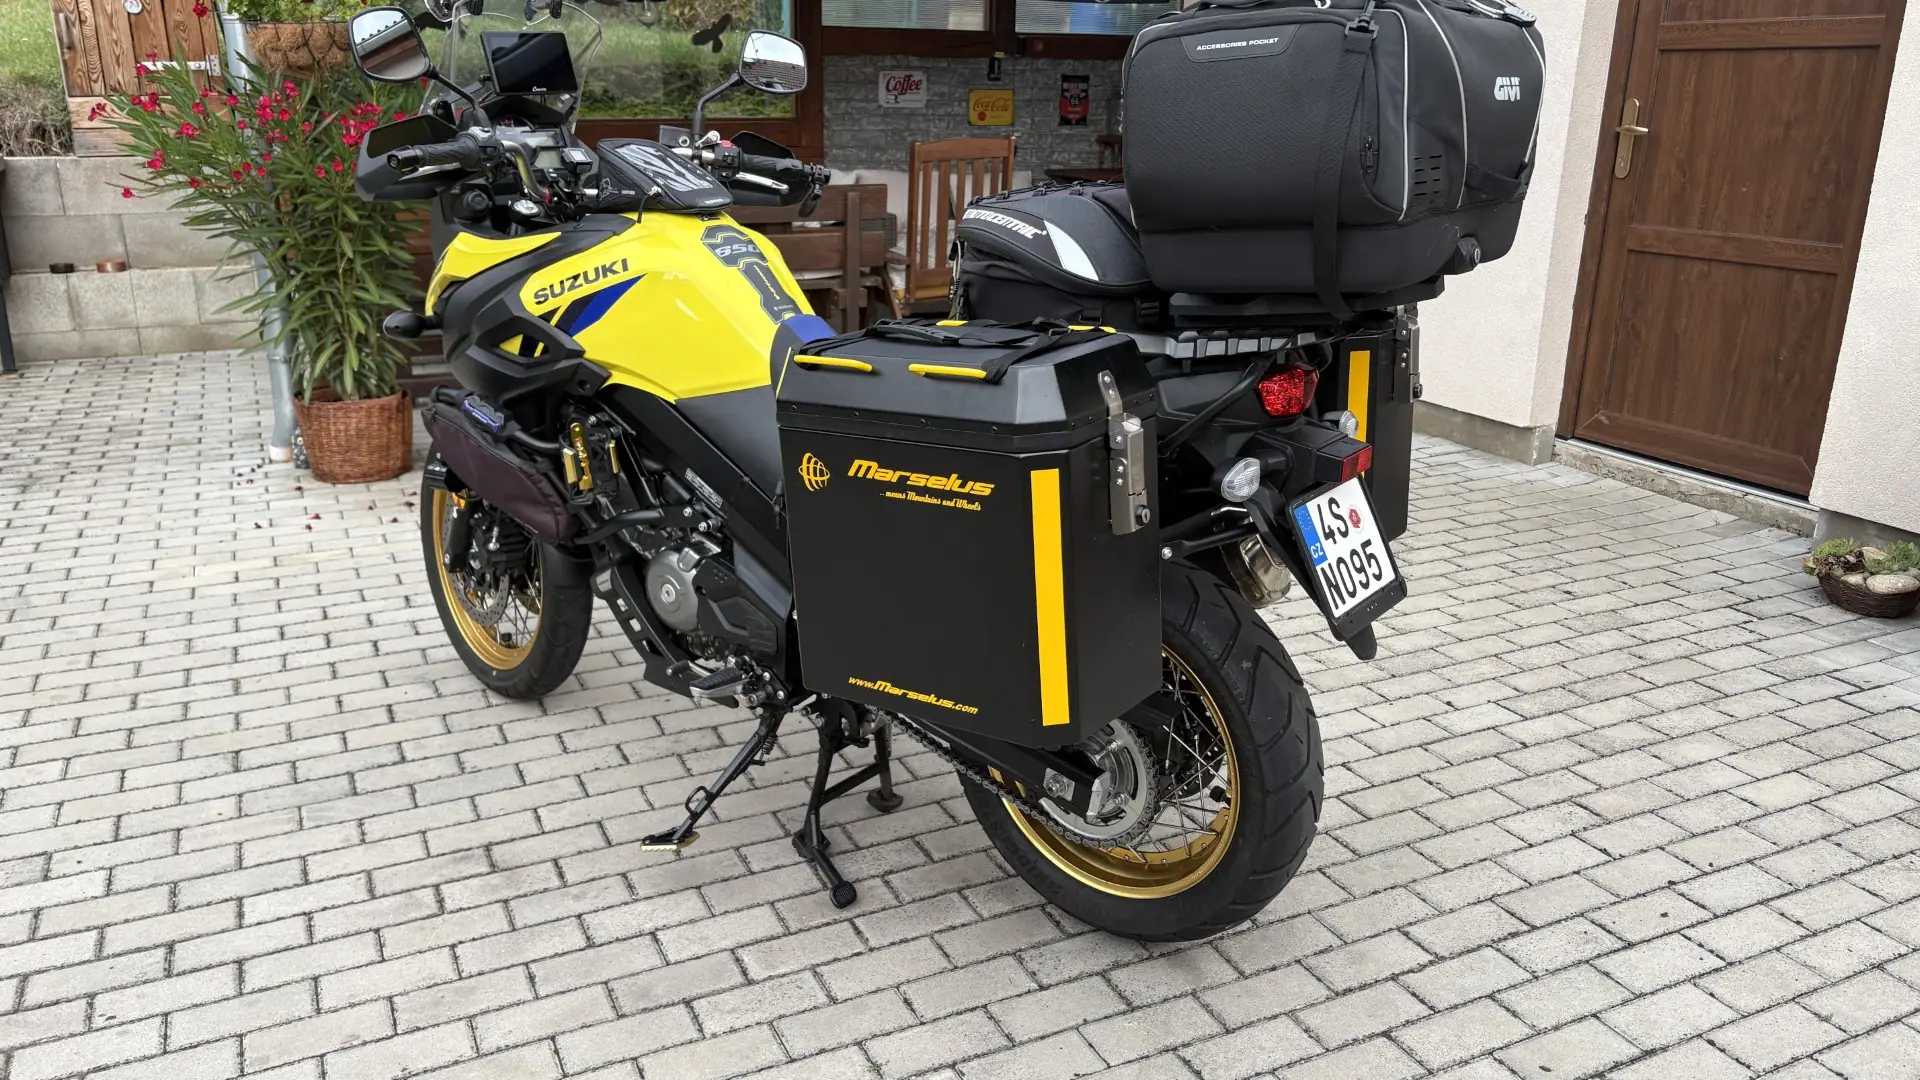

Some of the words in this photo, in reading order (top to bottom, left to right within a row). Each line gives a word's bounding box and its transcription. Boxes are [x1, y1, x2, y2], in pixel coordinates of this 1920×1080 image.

[1196, 41, 1247, 51] ACCESSORIES
[1248, 37, 1279, 46] POCKET
[885, 74, 922, 96] Coffee
[1493, 76, 1520, 102] GIVI
[533, 257, 630, 306] SUZUKI
[847, 458, 996, 497] Marselus
[886, 490, 906, 500] means
[906, 490, 941, 505] Mountains
[942, 497, 955, 507] and
[954, 498, 982, 512] Wheels
[1316, 496, 1349, 545] 4S
[1310, 542, 1325, 559] CZ
[848, 676, 979, 715] www.Marselus.com
